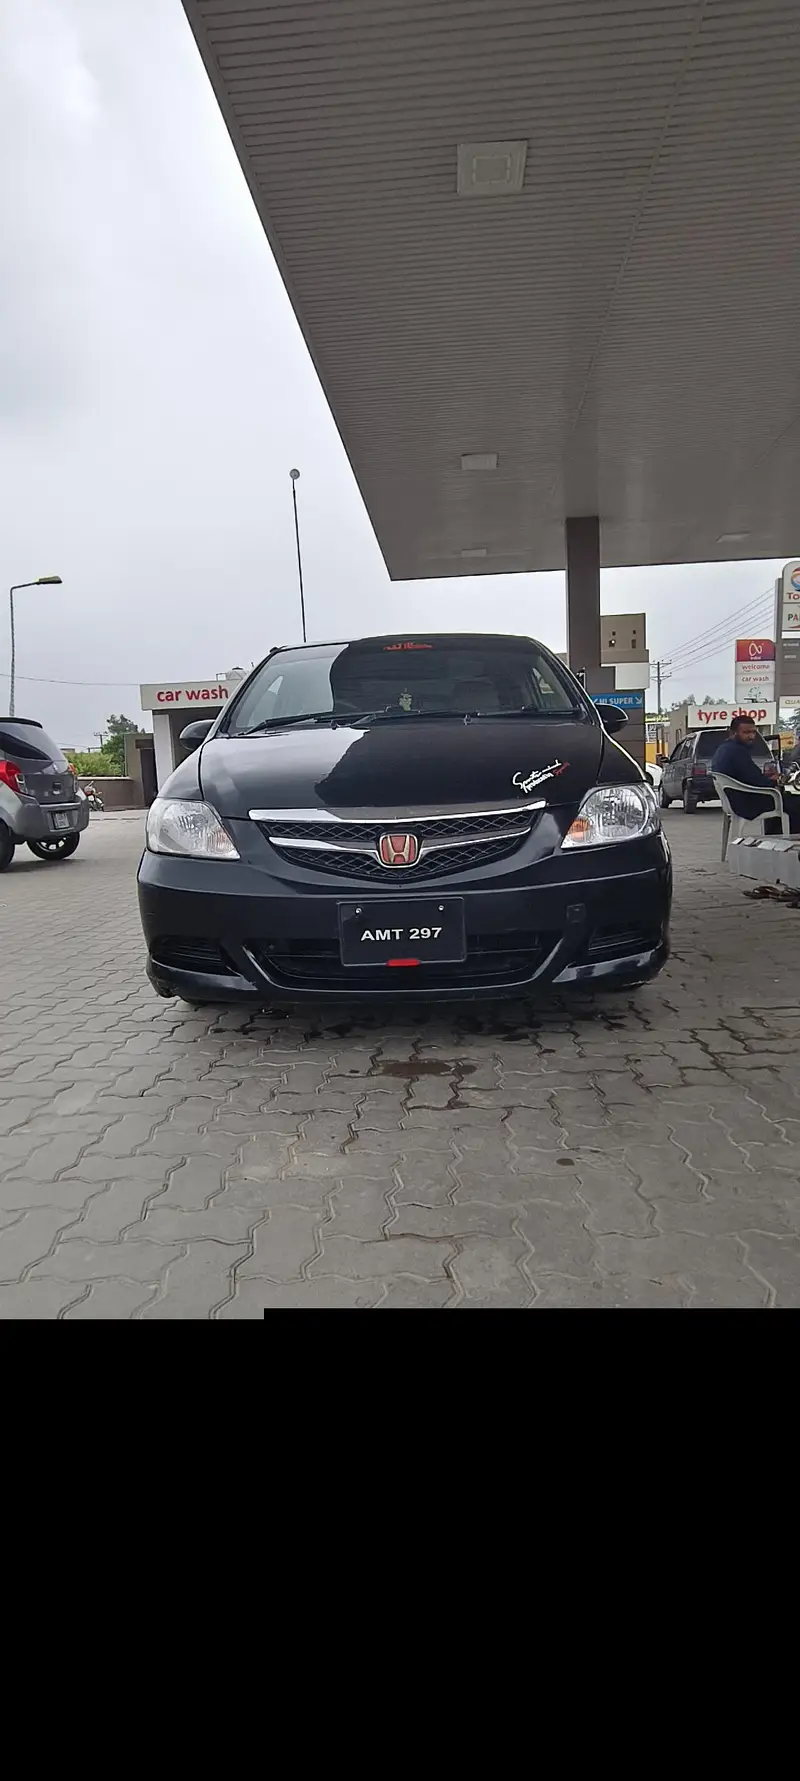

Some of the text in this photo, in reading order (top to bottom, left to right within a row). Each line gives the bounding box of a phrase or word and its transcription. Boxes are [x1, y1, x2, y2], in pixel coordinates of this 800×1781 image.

[787, 613, 800, 621] PA
[156, 685, 229, 702] car wash
[609, 697, 634, 705] SUPER
[697, 707, 767, 724] tyre shop
[360, 927, 442, 942] AMT 297
